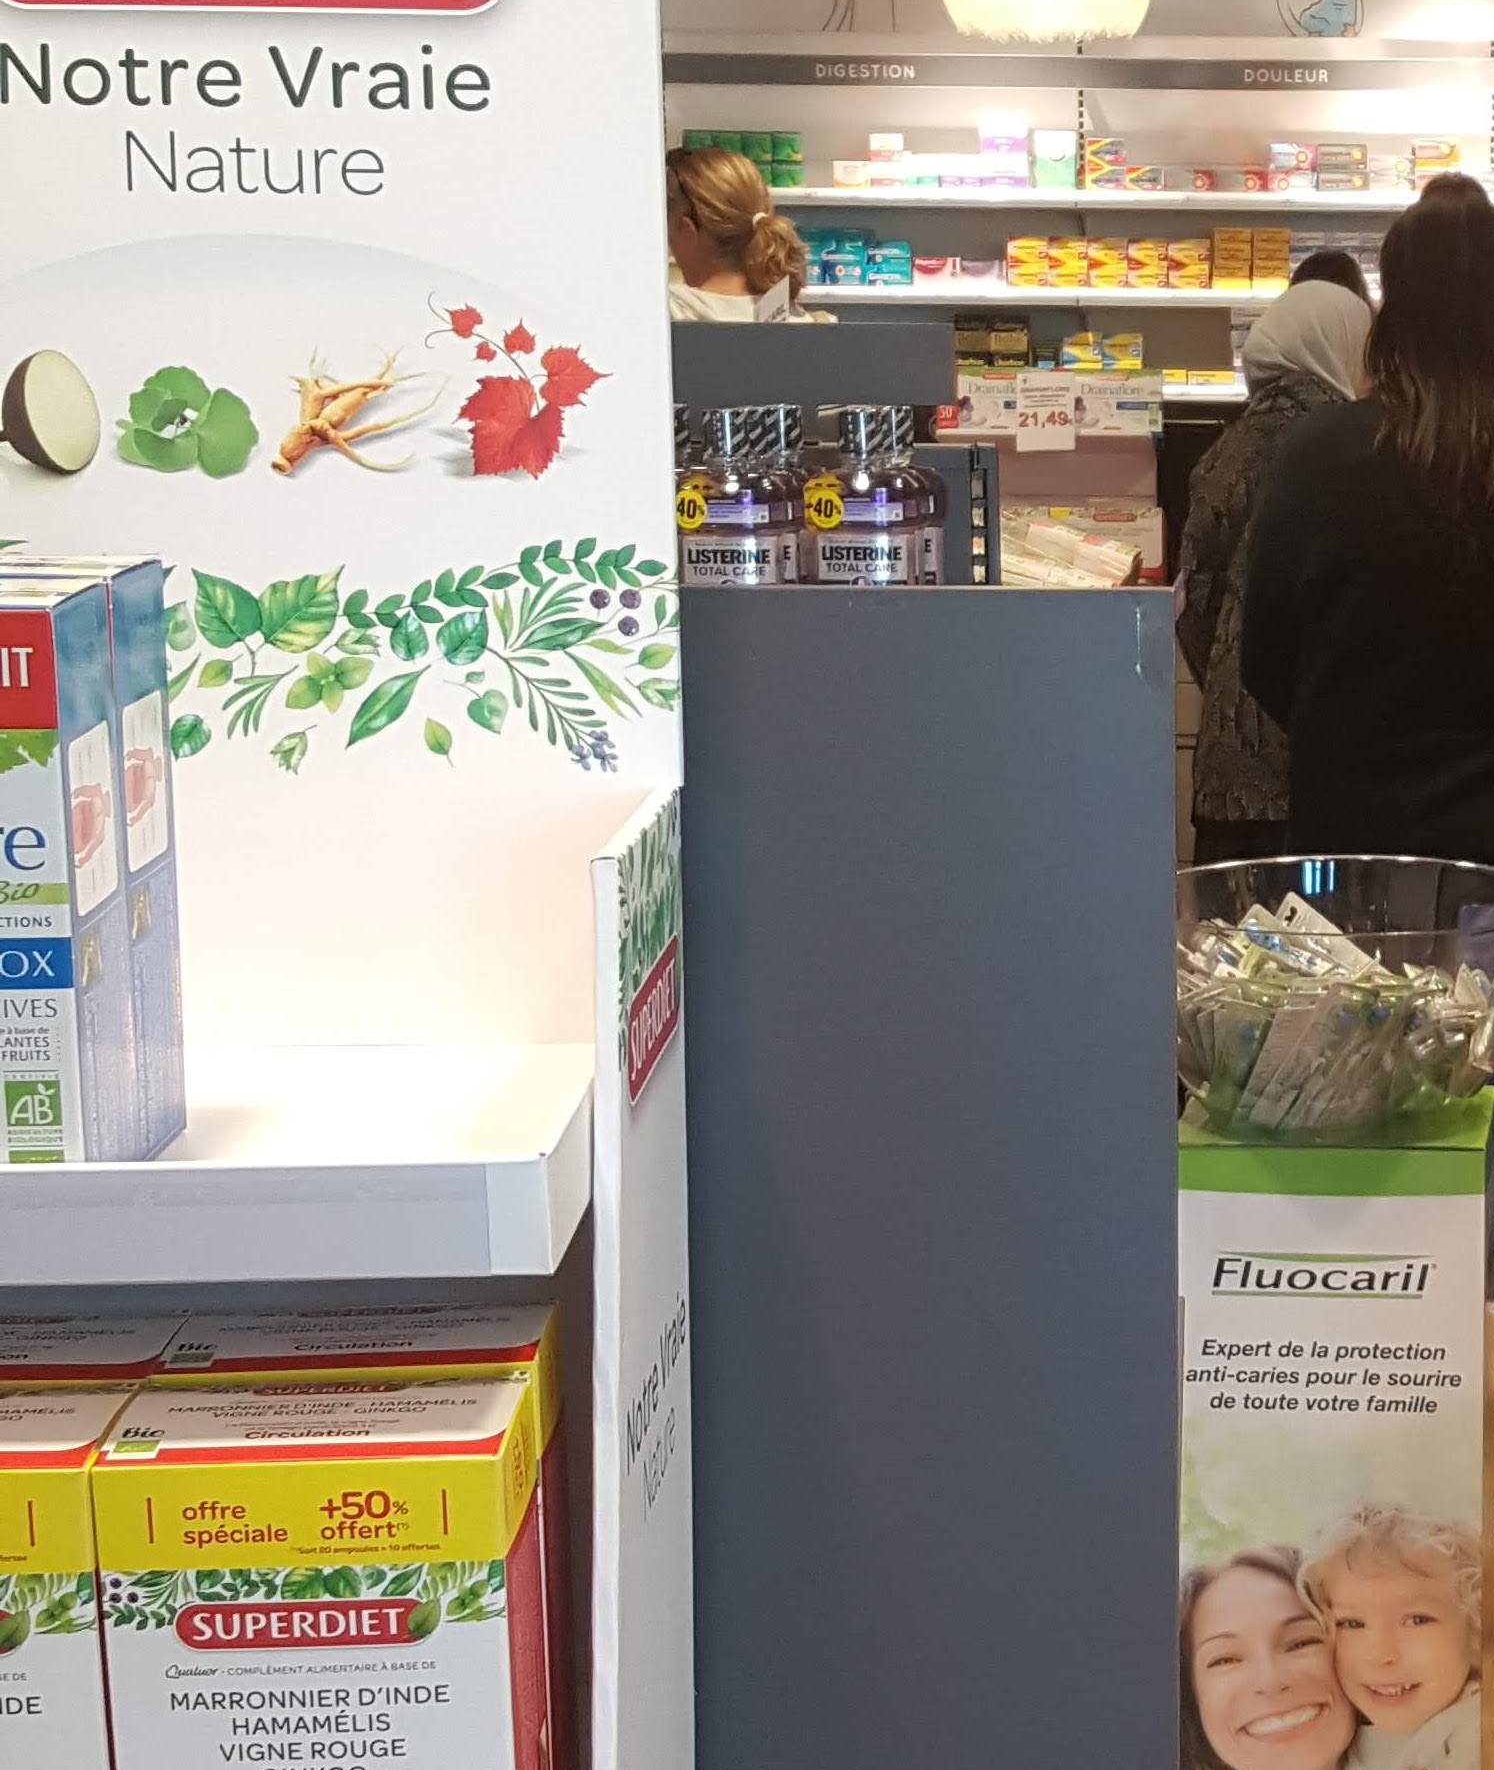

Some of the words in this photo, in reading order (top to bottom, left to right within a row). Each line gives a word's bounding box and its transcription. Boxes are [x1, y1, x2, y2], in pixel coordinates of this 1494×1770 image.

[0, 43, 242, 107] Notre
[269, 45, 491, 112] Vraie
[815, 62, 916, 80] DIGESTION
[1244, 67, 1329, 84] DOULEUR
[124, 130, 386, 197] Nature
[688, 548, 771, 565] LISTERINE
[821, 545, 902, 561] LISTERINE
[693, 565, 729, 576] TOTAL
[733, 565, 766, 576] CARE
[825, 562, 863, 573] TOTAL
[865, 561, 898, 573] CARE
[631, 957, 676, 1081] SUPERDIET
[10, 1094, 54, 1125] AB
[1212, 1258, 1431, 1293] Fluocaril
[1201, 1339, 1271, 1359] Expert
[1278, 1340, 1304, 1358] de
[1311, 1341, 1329, 1359] la
[1335, 1342, 1446, 1363] protection
[627, 1363, 659, 1476] Notre
[660, 1292, 686, 1390] Vraie
[1185, 1366, 1300, 1385] anti-caries
[1305, 1370, 1357, 1388] pour
[1362, 1369, 1381, 1386] le
[1388, 1371, 1462, 1388] sourire
[1209, 1392, 1236, 1410] de
[1243, 1394, 1299, 1411] toute
[1306, 1395, 1359, 1411] votre
[1366, 1395, 1438, 1413] famille
[245, 1428, 371, 1440] Circulation
[182, 1501, 246, 1521] offre
[319, 1490, 409, 1520] +50%
[183, 1524, 288, 1548] spéciale
[192, 1608, 405, 1641] SUPERDIET
[227, 1665, 303, 1676] COMPLÉMENT
[307, 1663, 378, 1674] ALIMENTAIRE
[422, 1661, 436, 1670] DE
[170, 1689, 350, 1711] MARRONNIER
[358, 1685, 450, 1707] D'INDE
[233, 1710, 391, 1736] HAMAMÉLIS
[220, 1742, 302, 1762] VIGNE
[311, 1739, 407, 1760] ROUGE
